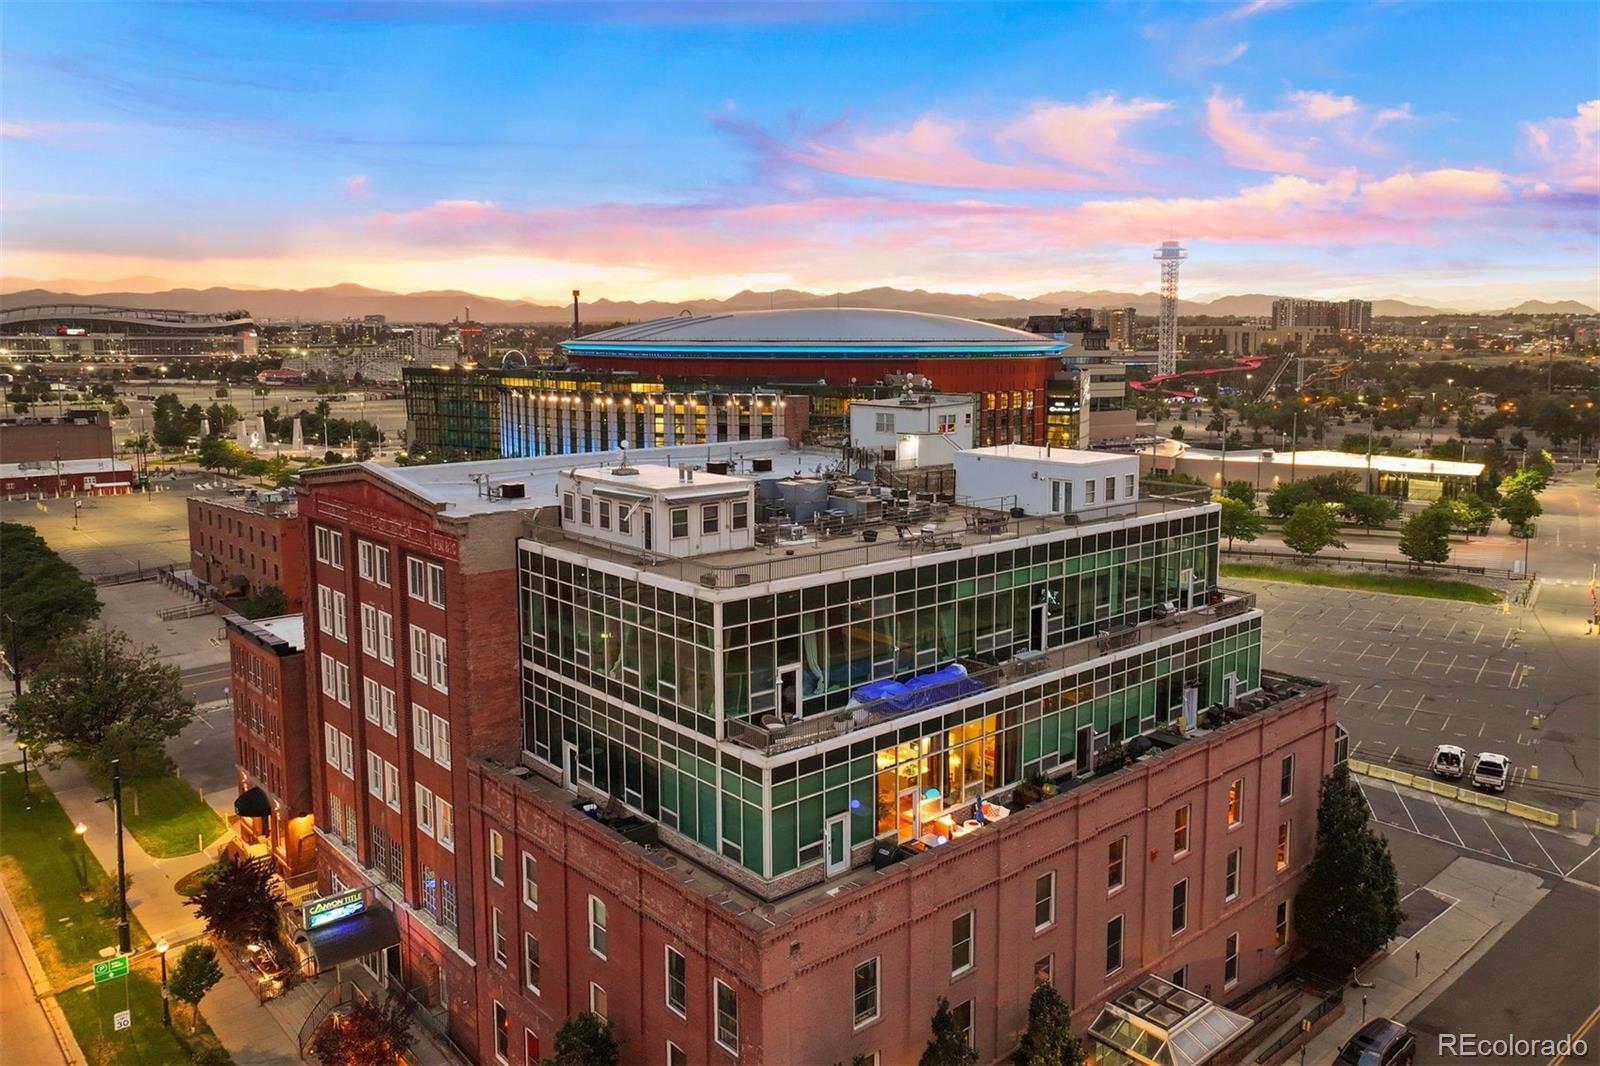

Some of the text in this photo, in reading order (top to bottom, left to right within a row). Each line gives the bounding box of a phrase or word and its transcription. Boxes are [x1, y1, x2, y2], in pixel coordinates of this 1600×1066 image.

[309, 899, 343, 915] CANYON
[343, 893, 362, 904] TITLE
[117, 1020, 129, 1028] 30
